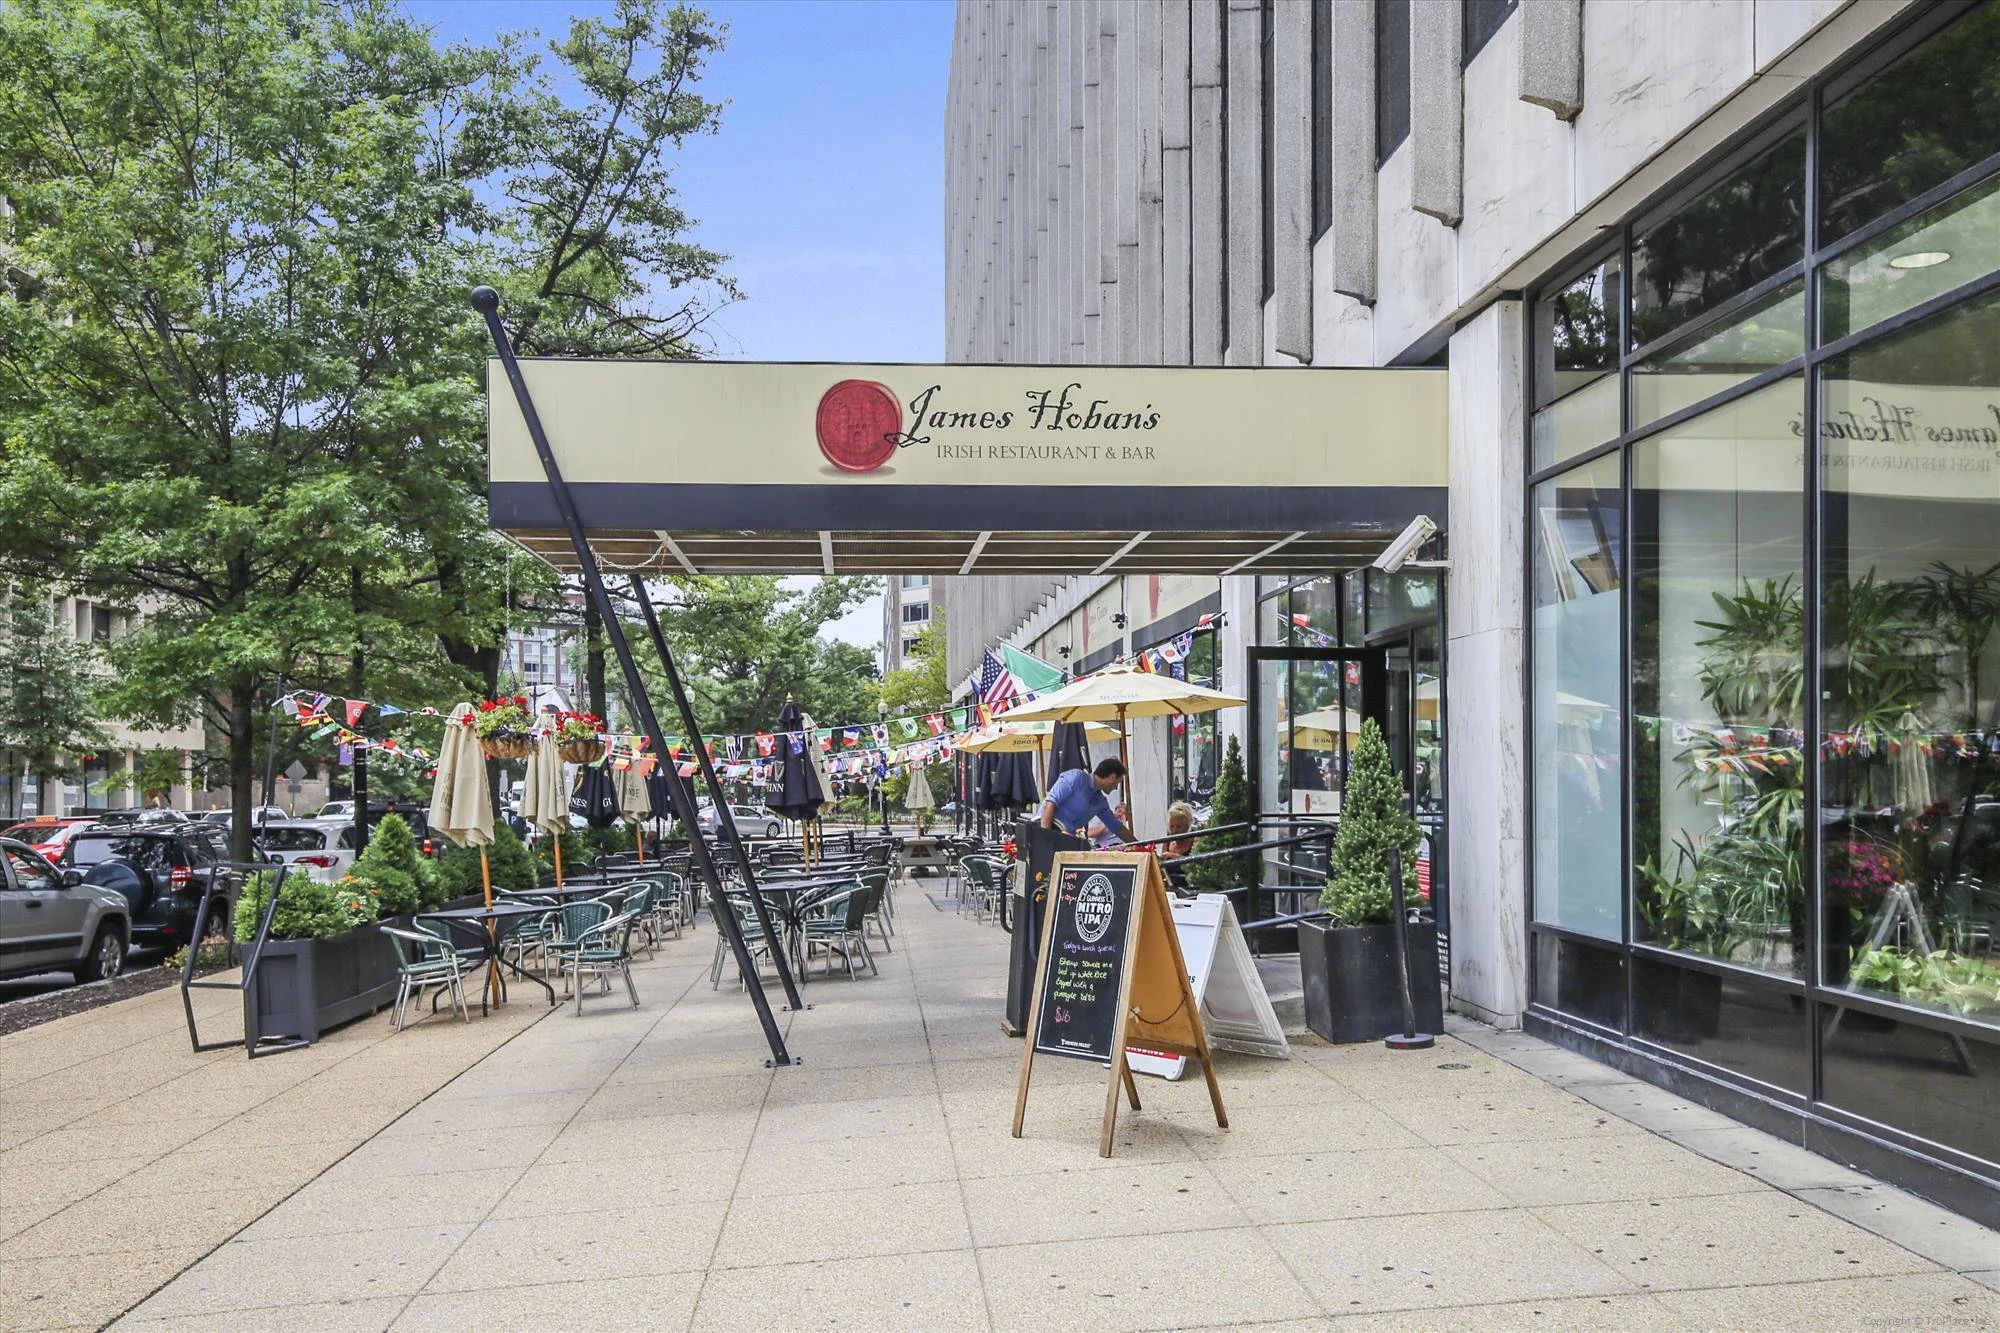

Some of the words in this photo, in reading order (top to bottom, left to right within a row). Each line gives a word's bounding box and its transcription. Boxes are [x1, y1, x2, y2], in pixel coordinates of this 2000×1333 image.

[884, 385, 1013, 447] James
[1026, 383, 1161, 431] Hoban's
[937, 445, 982, 459] IRISH
[989, 445, 1101, 460] RESTAURANT
[1106, 447, 1117, 459] &
[1122, 446, 1157, 460] BAR
[1077, 902, 1112, 914] NITRO
[1084, 913, 1101, 925] IPA
